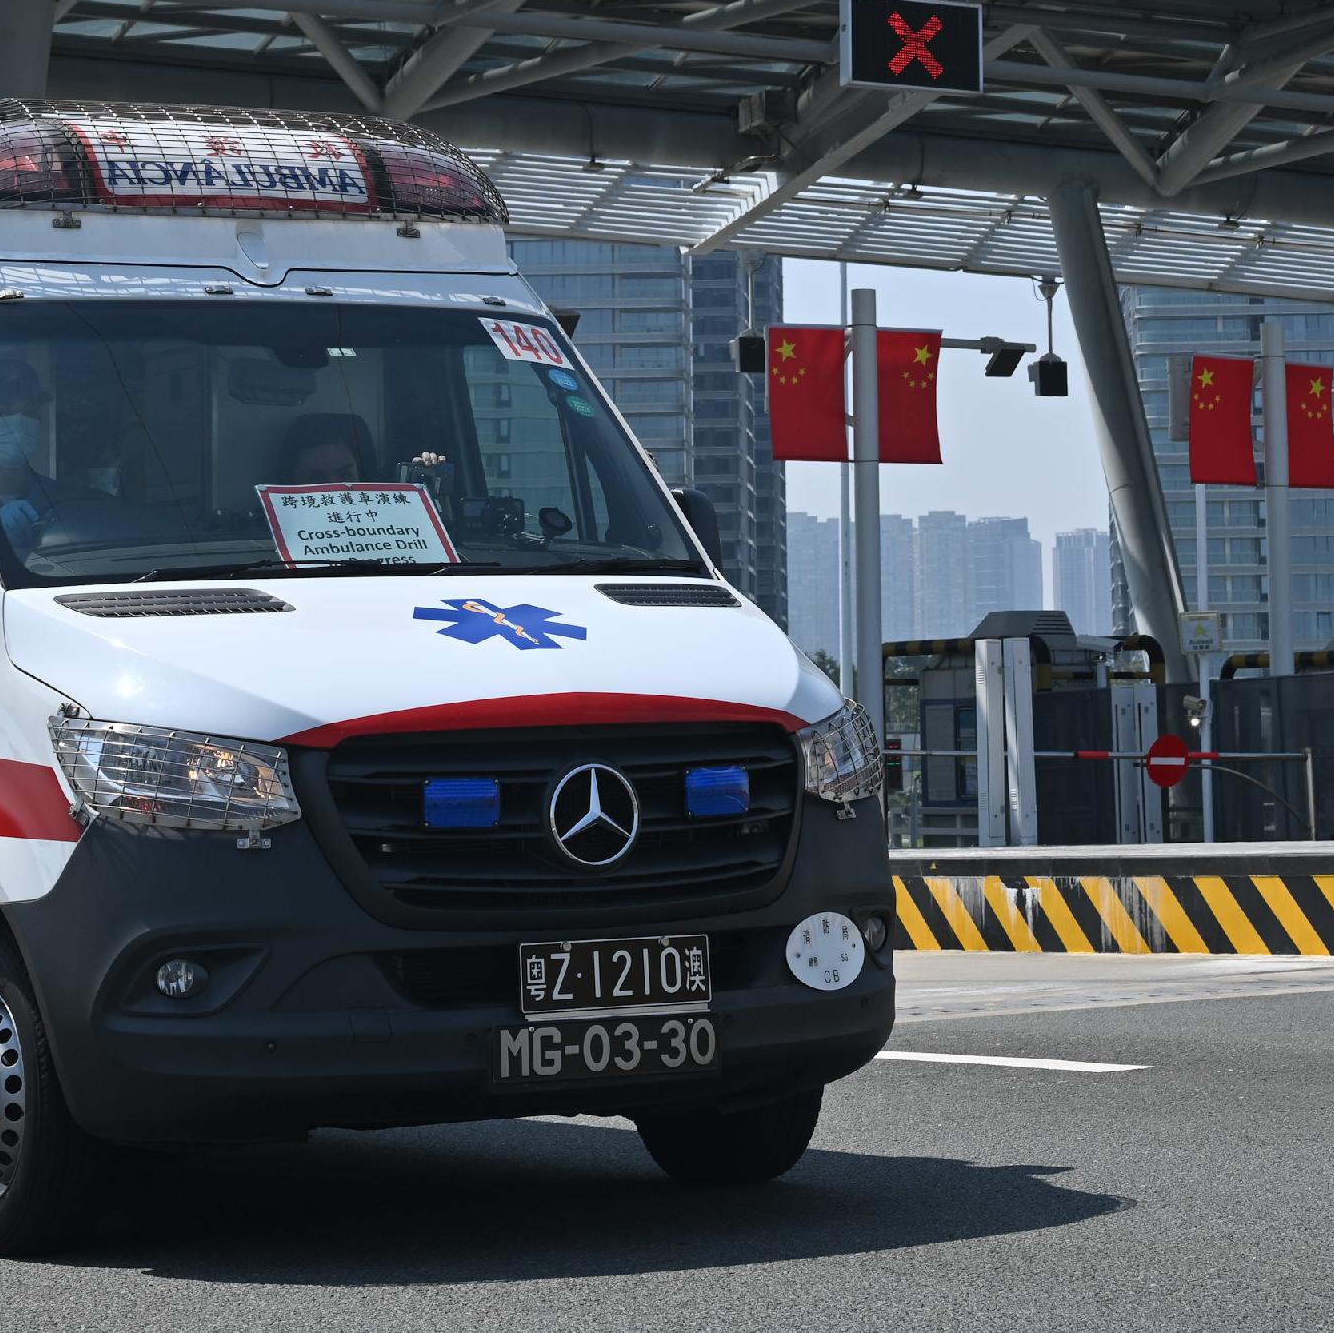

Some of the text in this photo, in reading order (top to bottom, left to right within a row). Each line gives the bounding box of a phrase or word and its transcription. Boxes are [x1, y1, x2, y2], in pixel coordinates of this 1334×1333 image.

[492, 323, 563, 364] 140
[281, 492, 411, 509] 跨境救護車演練
[327, 510, 378, 523] 進行中
[298, 524, 419, 541] Cross-boundary
[304, 539, 428, 555] Ambulance Drill
[500, 1018, 716, 1078] MG-03-30
